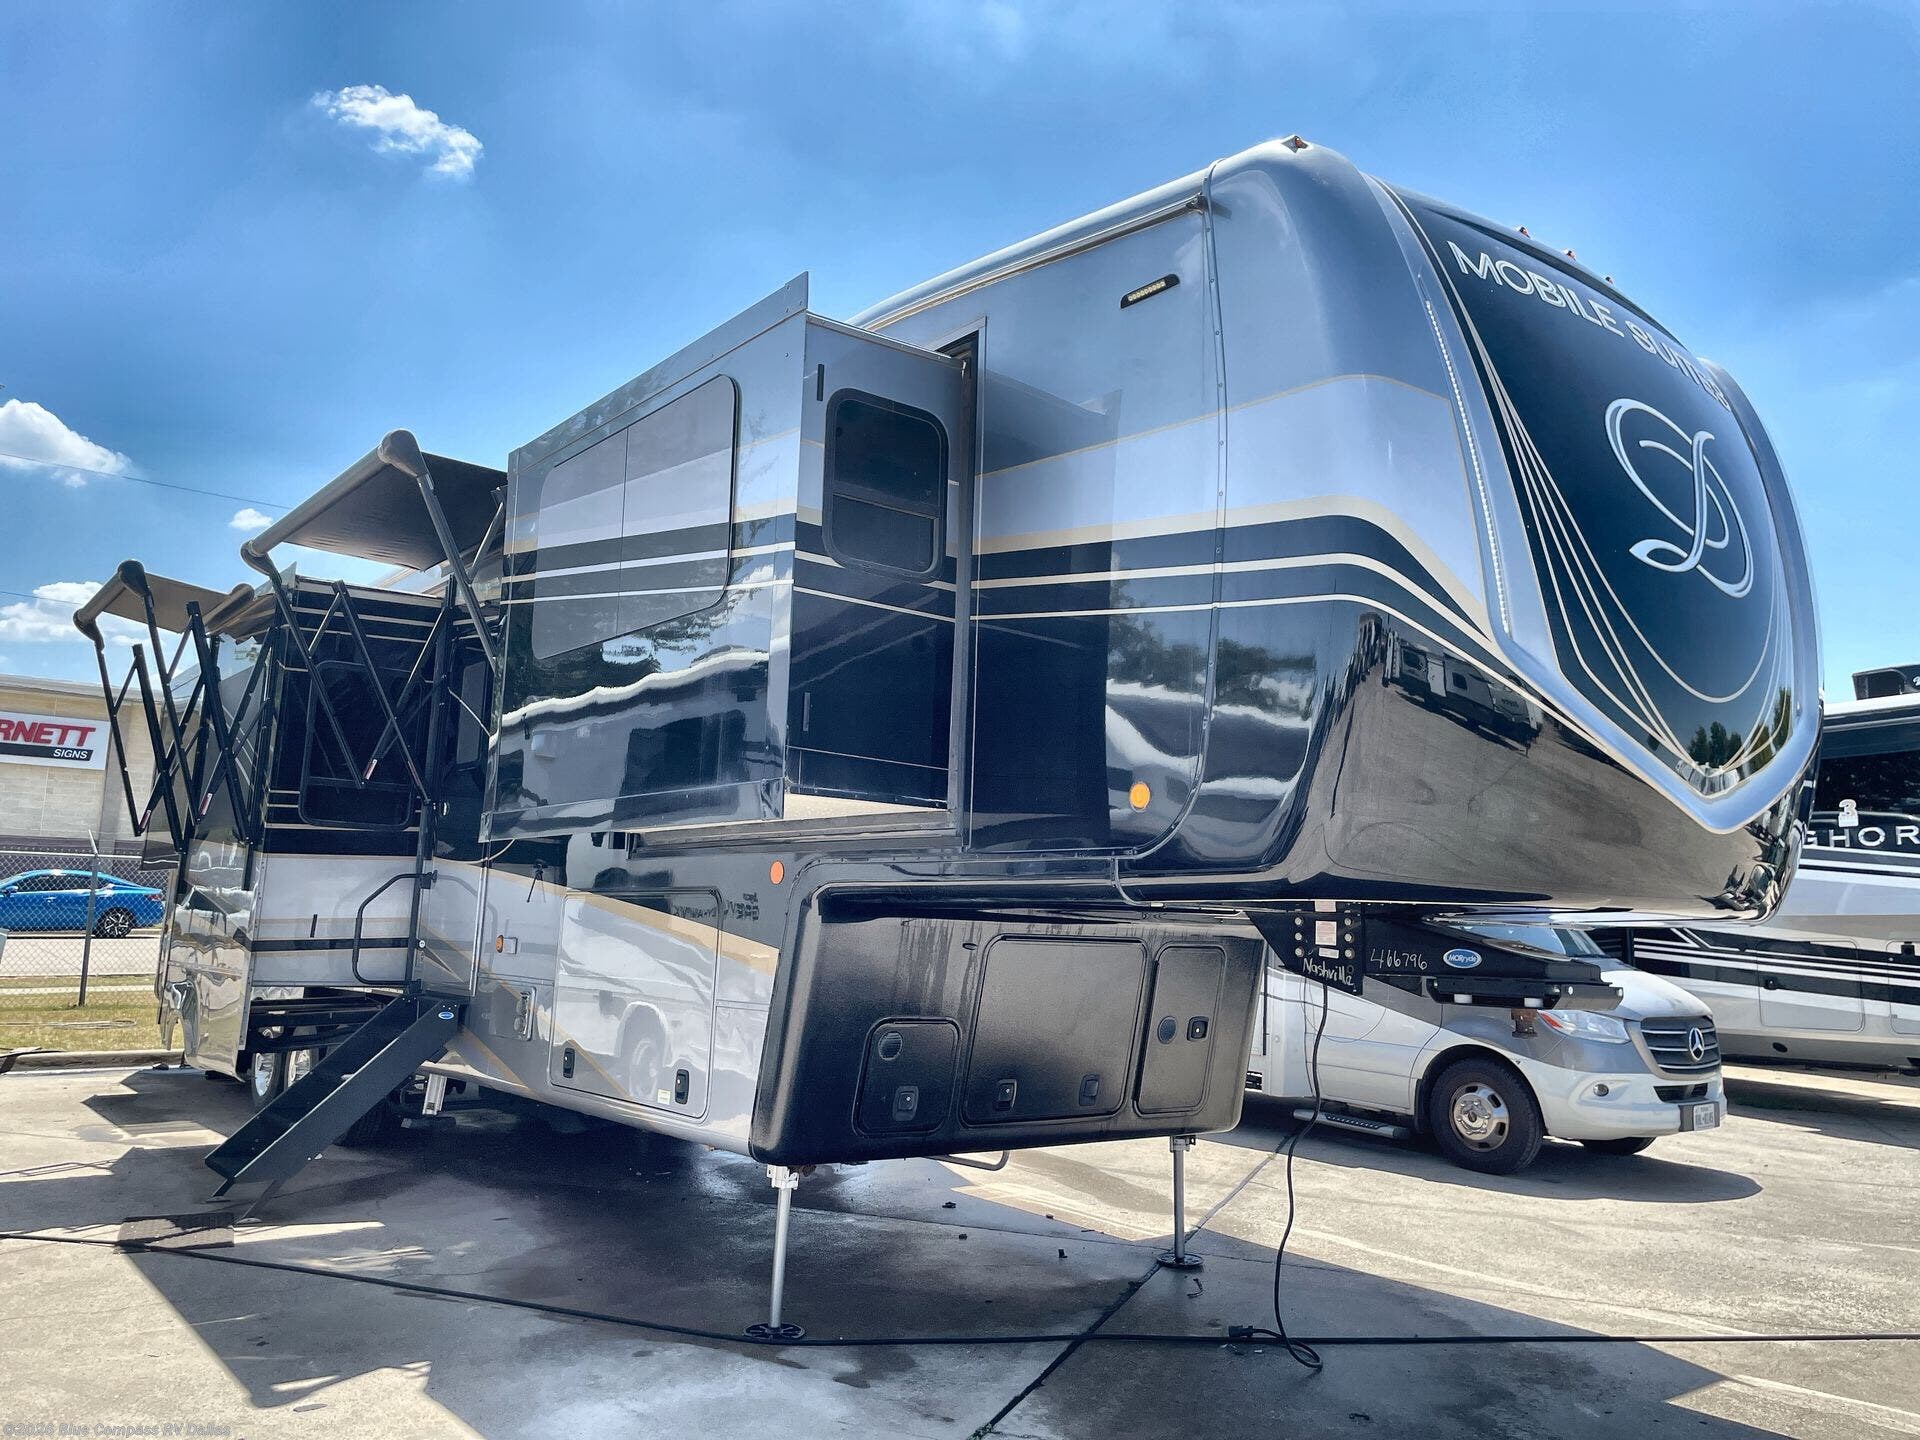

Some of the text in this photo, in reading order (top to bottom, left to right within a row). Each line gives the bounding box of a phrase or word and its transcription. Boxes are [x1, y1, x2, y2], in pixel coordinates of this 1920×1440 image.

[1447, 240, 1732, 412] MOBILE SUITES
[53, 748, 88, 759] SIGNS
[1838, 798, 1858, 816] 3
[1370, 948, 1428, 971] 466796
[1302, 957, 1355, 986] Nashville
